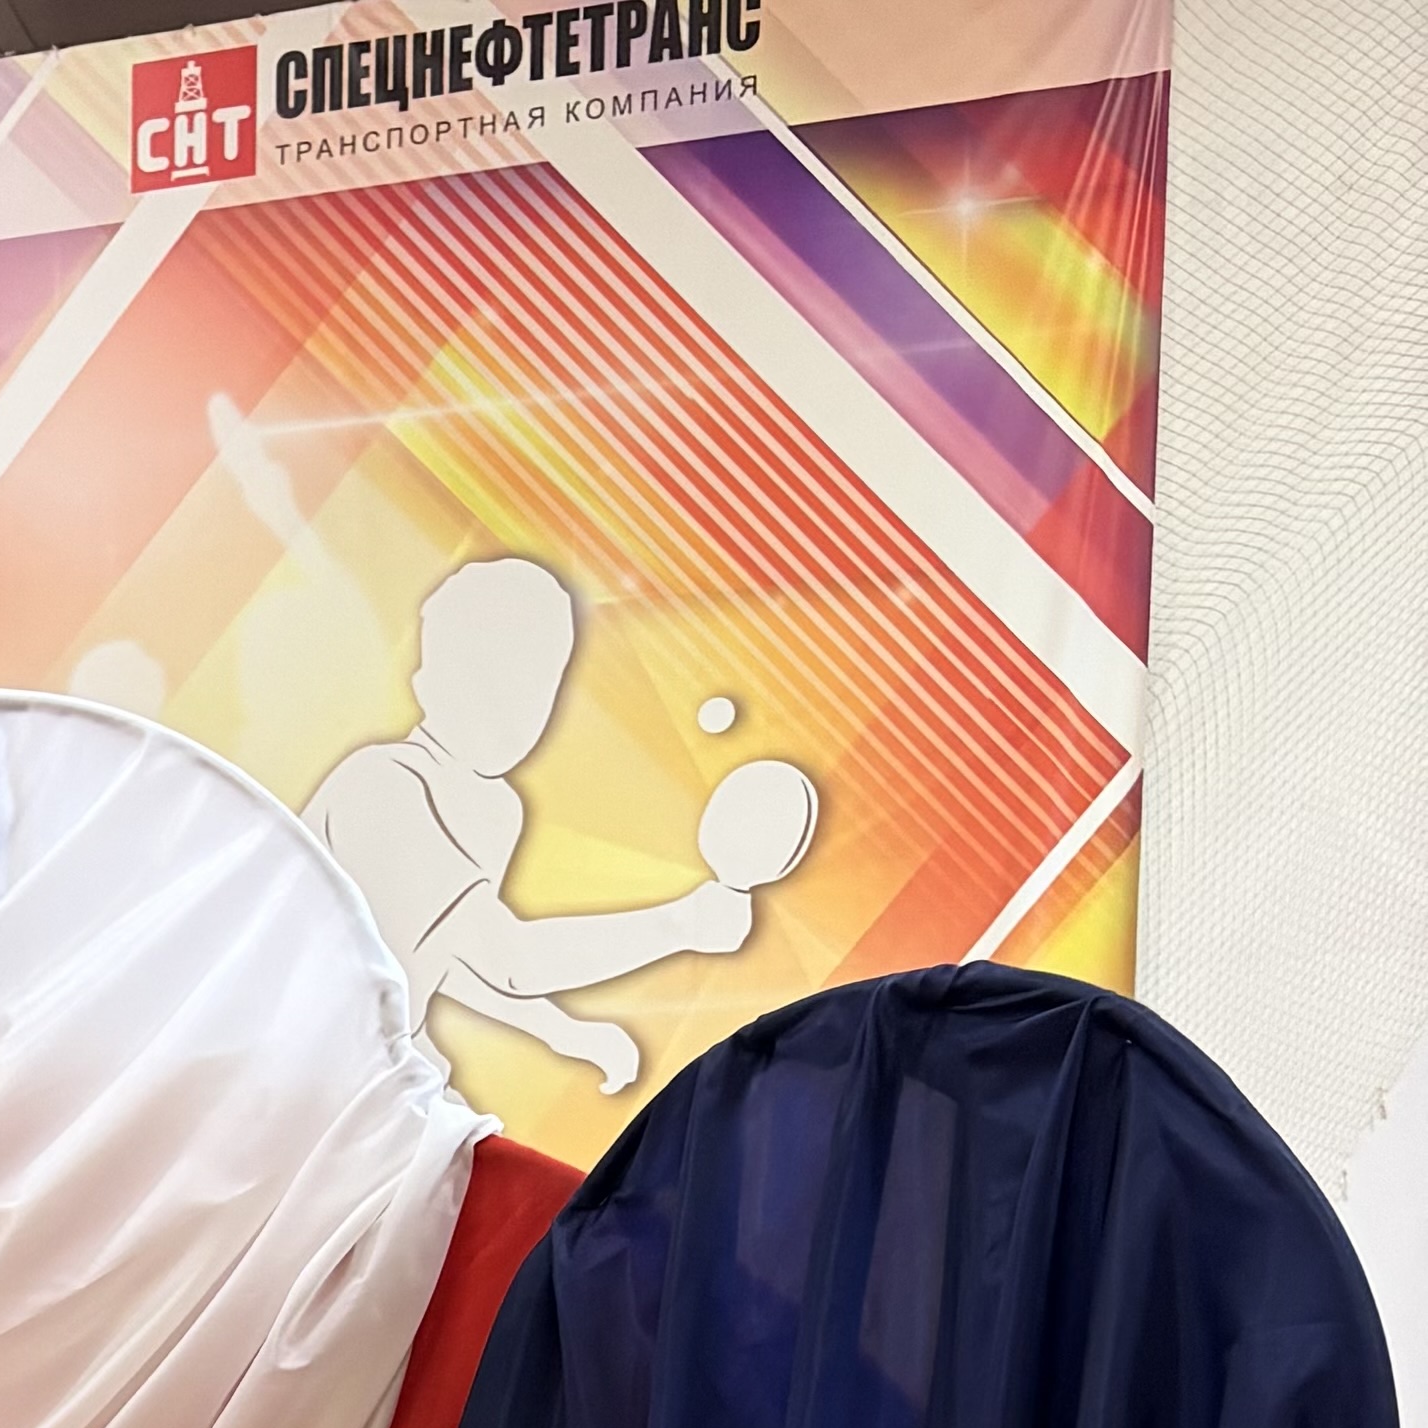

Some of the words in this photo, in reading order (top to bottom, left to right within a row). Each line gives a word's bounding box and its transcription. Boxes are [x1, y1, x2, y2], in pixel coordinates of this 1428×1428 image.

[275, 0, 761, 118] СПЕЦНЕФТЕТРАНС
[137, 105, 251, 172] СНТ
[276, 107, 545, 166] ТРАНСПОРТНАЯ
[566, 75, 758, 123] КОМПАНИЯ
